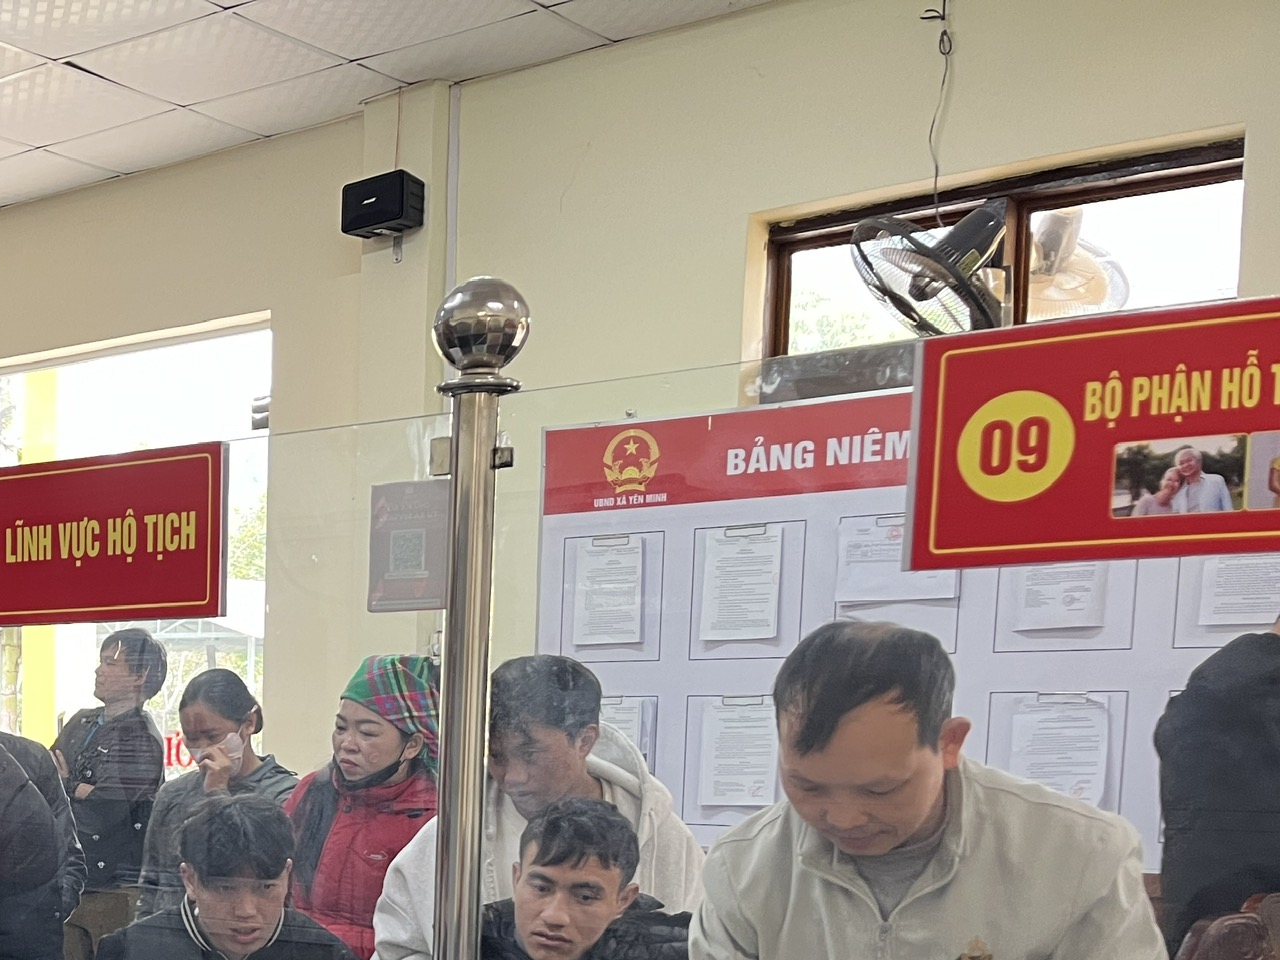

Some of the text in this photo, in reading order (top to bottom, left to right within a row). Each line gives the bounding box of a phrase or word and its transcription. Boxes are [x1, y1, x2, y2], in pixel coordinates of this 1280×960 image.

[1083, 370, 1123, 428] BỘ
[1131, 363, 1212, 422] PHẬN
[1221, 349, 1261, 409] HỖ
[726, 427, 911, 476] BẢNG NIÊM
[979, 415, 1050, 476] 09
[593, 497, 615, 508] UBND
[628, 493, 644, 505] YÊN
[645, 492, 667, 503] MINH
[5, 508, 196, 567] LĨNH VỰC HỘ TỊCH
